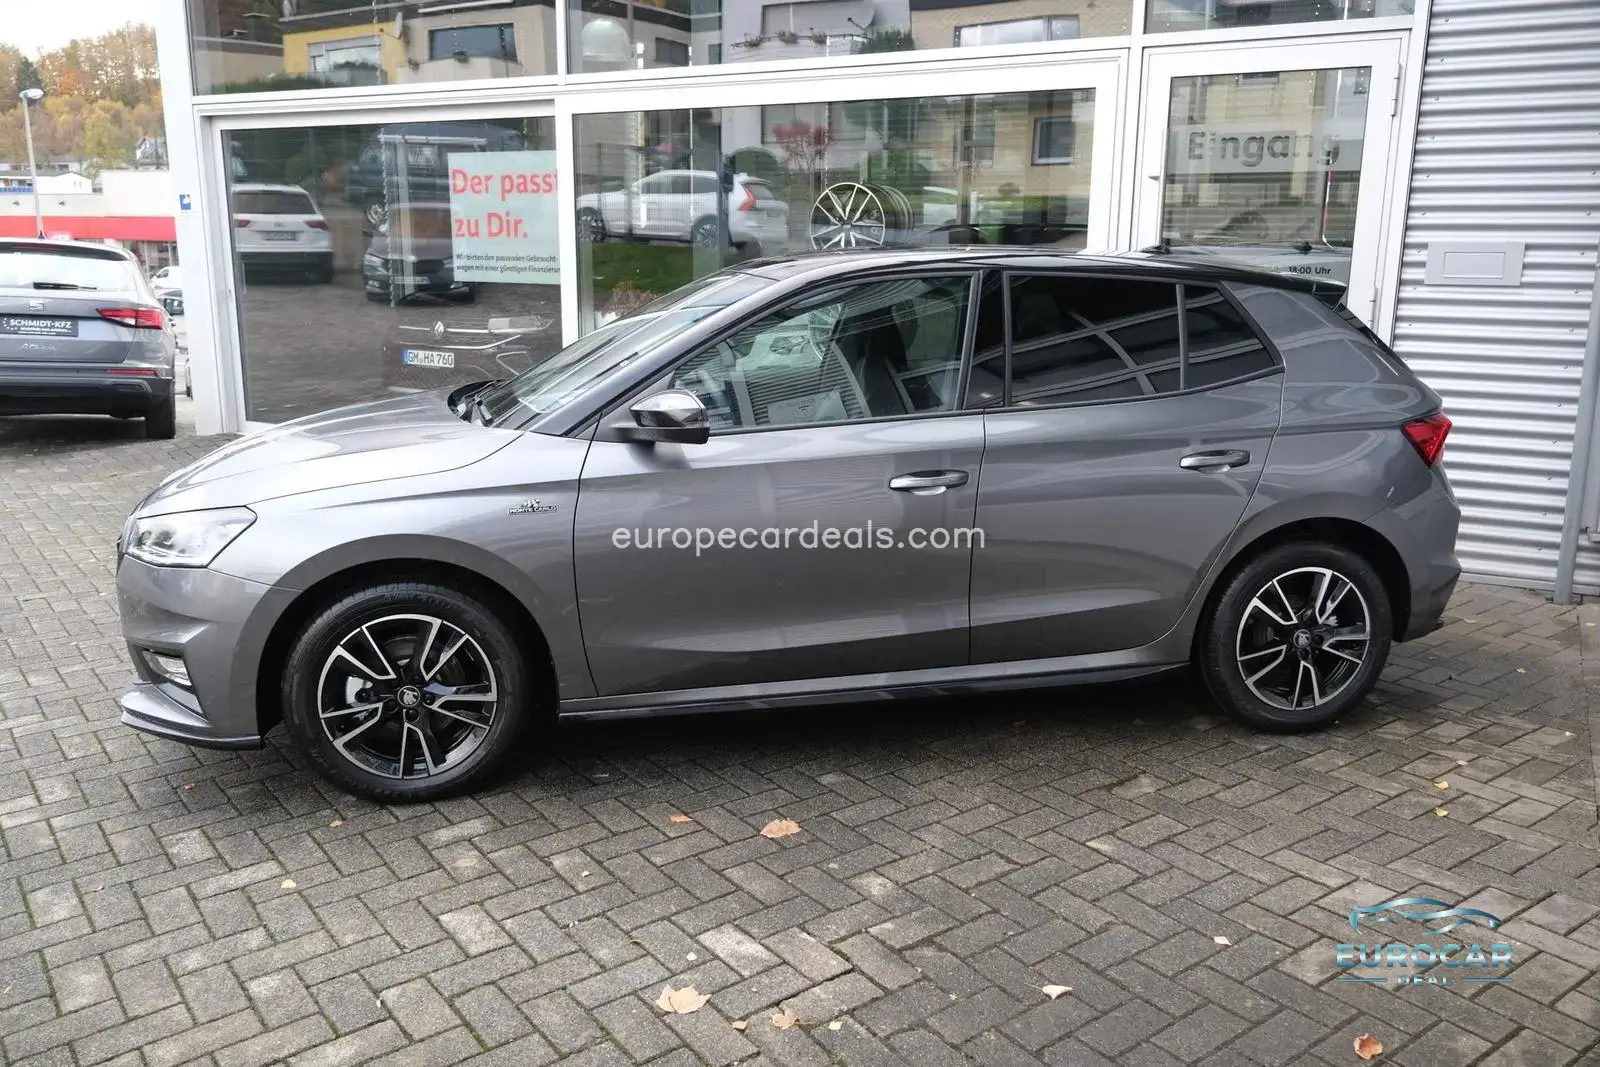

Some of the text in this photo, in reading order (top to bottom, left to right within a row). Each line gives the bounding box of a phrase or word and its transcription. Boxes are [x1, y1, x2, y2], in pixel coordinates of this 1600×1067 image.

[452, 168, 494, 194] Der
[454, 210, 528, 239] zu Dir.
[1314, 266, 1332, 275] Uhr
[9, 319, 73, 329] SCHMIDT-KFZ
